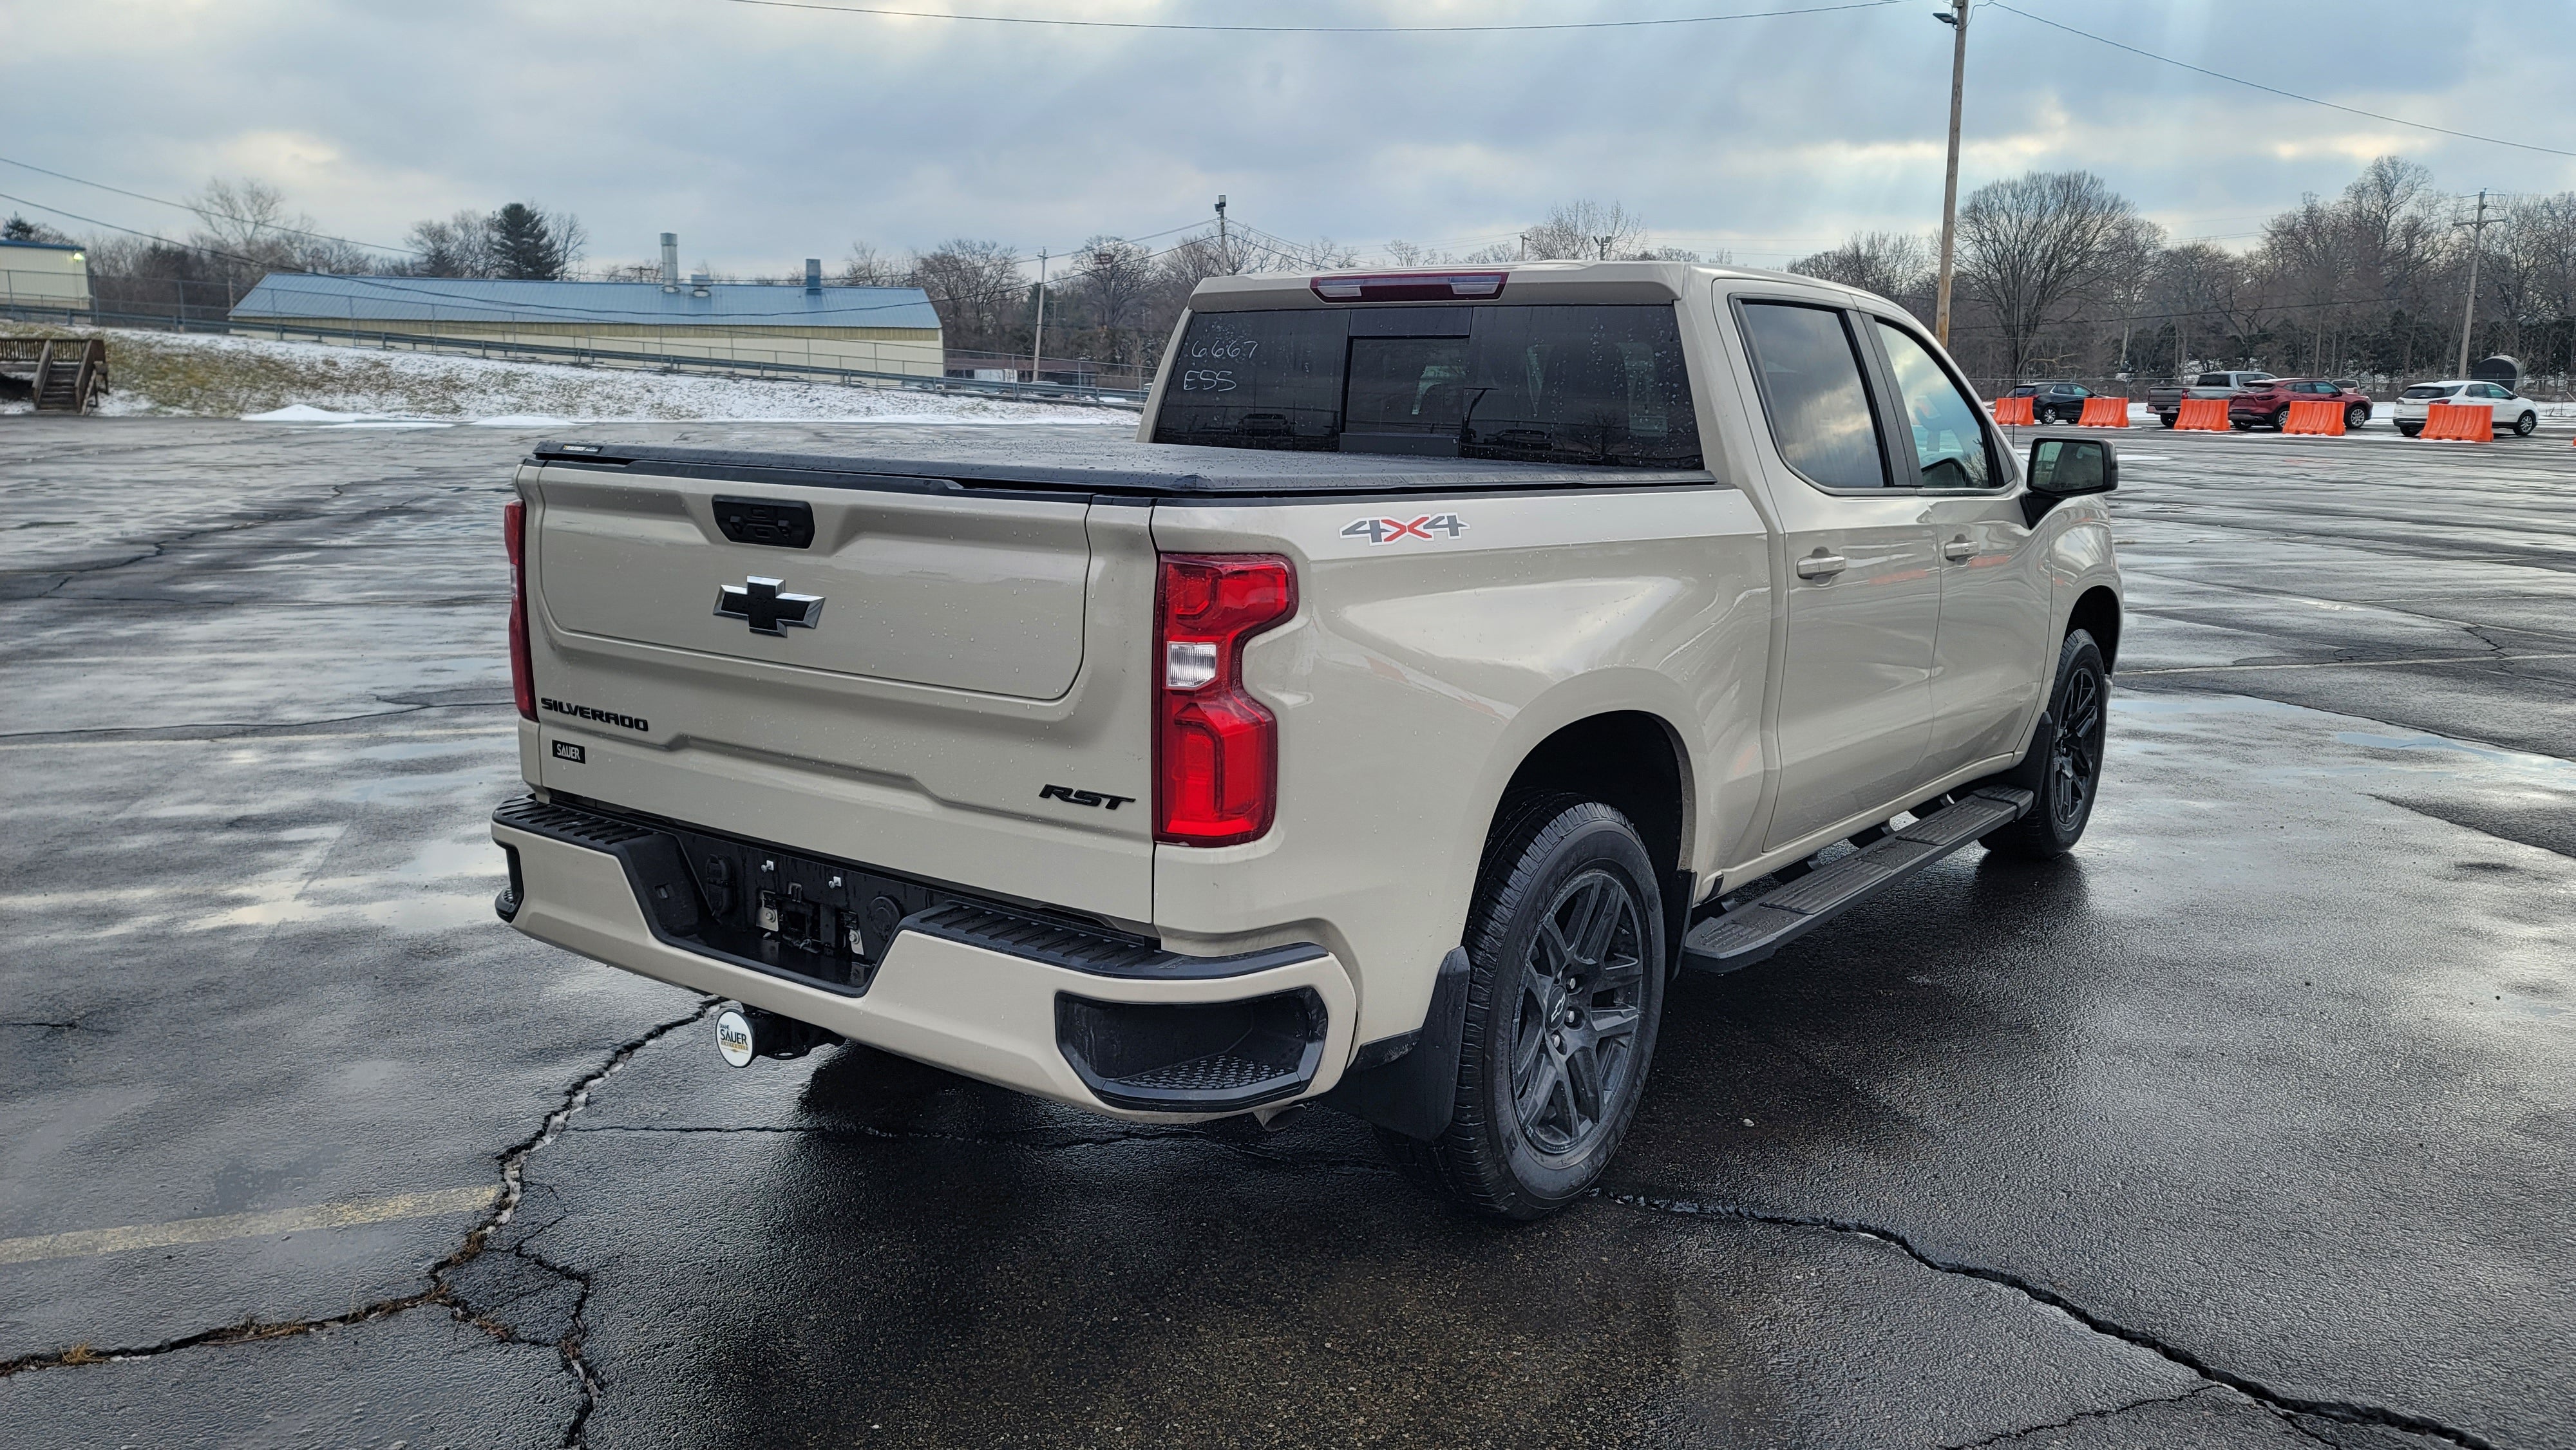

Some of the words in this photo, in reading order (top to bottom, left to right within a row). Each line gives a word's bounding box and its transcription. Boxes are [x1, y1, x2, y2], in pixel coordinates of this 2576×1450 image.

[1191, 340, 1258, 359] 6667
[540, 697, 649, 731] SILVERADO
[556, 743, 581, 760] SAUER
[1038, 783, 1136, 810] RST
[720, 1028, 748, 1046] SAUER
